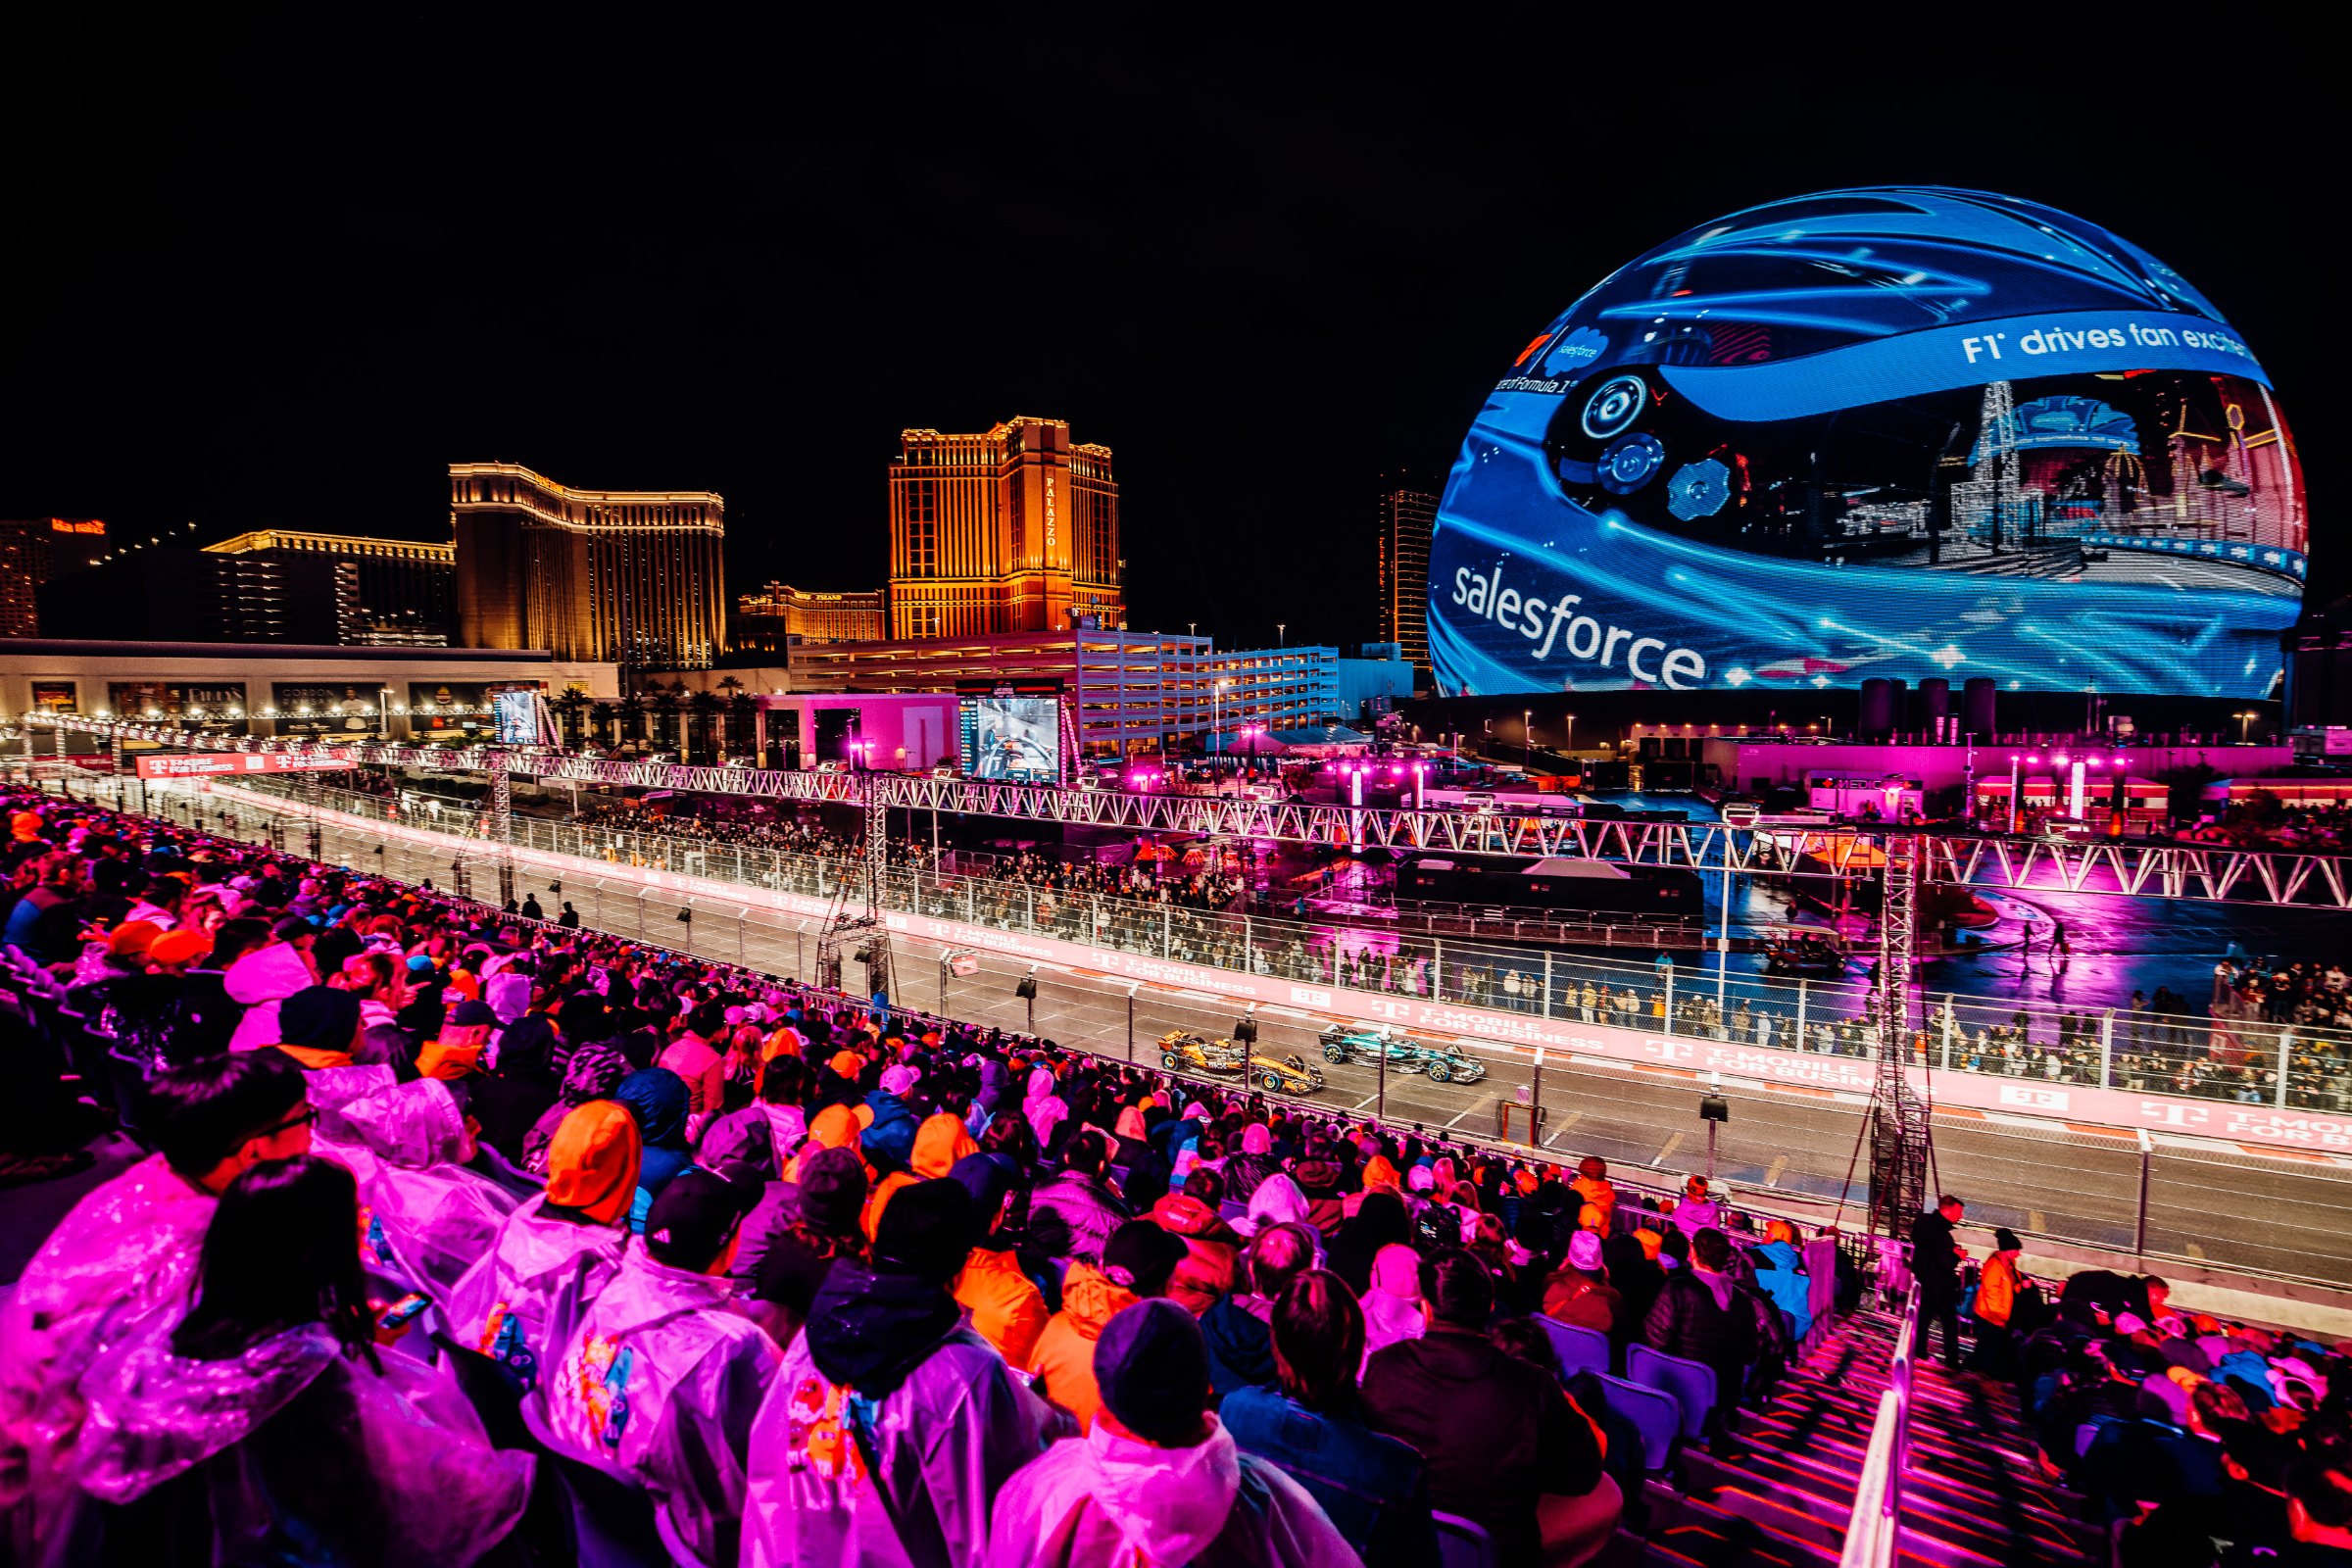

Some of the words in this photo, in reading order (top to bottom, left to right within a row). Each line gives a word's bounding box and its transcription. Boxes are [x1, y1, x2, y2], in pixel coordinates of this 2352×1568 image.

[1558, 343, 1597, 359] salesforce
[2020, 326, 2127, 355] drives
[2129, 322, 2180, 346] fan
[1516, 376, 1559, 393] Formula
[1046, 477, 1056, 546] PALAZZO
[1452, 566, 1706, 690] salesforce
[953, 933, 982, 944] FOR
[983, 938, 1054, 956] BUSINESS
[954, 927, 1020, 945] T-MOBILE
[1126, 965, 1163, 978] FOR
[1163, 972, 1257, 995] BUSINESS
[1127, 957, 1211, 980] T-MOBILE
[1421, 1006, 1542, 1032] T-MOBILE
[1419, 1015, 1470, 1031] FOR
[1473, 1023, 1605, 1050] BUSINESS
[1706, 1047, 1858, 1074] T-MOBILE
[1706, 1056, 1767, 1075] FOR
[1772, 1063, 1938, 1096] BUSINS
[2227, 1121, 2315, 1142] FOR
